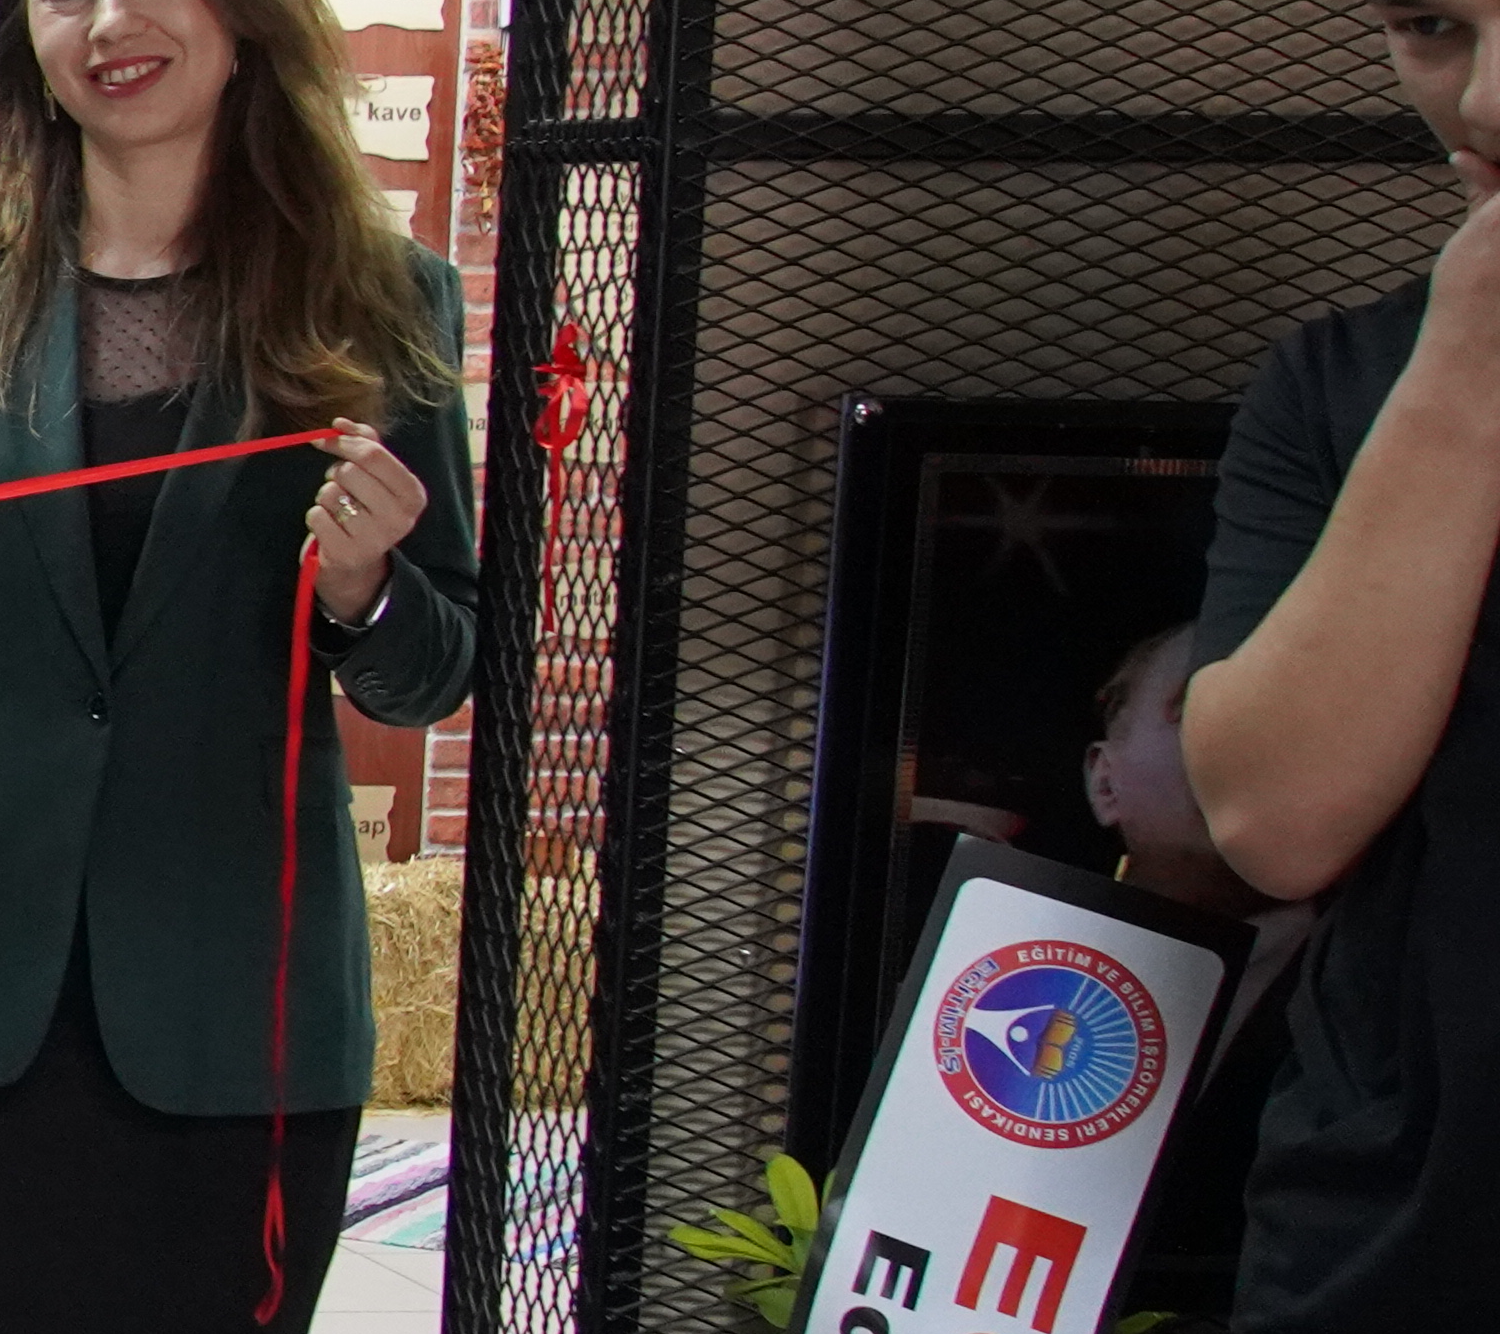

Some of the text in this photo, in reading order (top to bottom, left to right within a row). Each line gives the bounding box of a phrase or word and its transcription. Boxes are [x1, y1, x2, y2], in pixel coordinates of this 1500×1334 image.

[367, 101, 423, 122] kave
[1016, 944, 1092, 968] EĞİTİM
[1096, 961, 1120, 983] VE
[1119, 982, 1157, 1033] BİLİM
